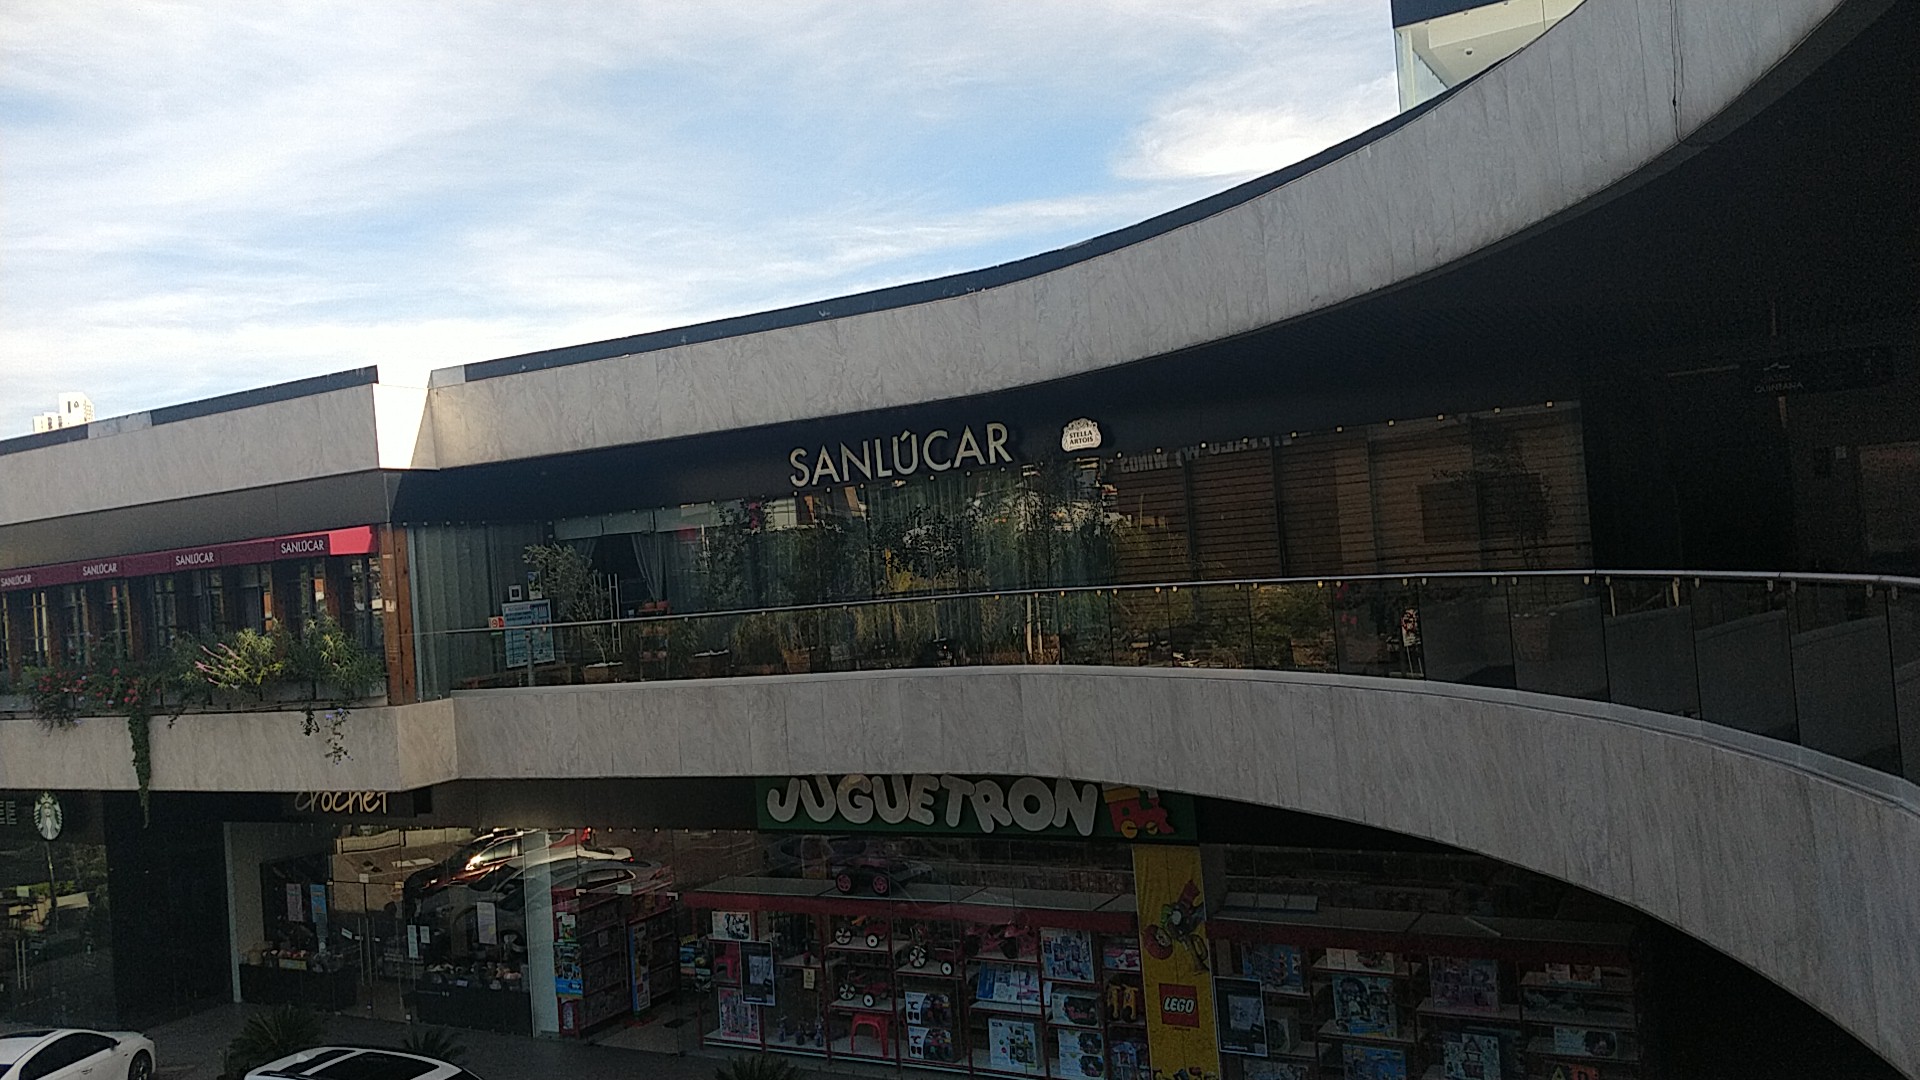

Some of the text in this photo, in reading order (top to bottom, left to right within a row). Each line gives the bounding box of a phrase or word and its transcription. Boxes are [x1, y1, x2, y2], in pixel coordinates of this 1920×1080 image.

[1069, 430, 1092, 439] STELLA
[1069, 436, 1093, 445] ARTOIS
[790, 422, 1013, 488] SANLÚCAR
[767, 774, 1098, 836] JUGUETRON
[1163, 995, 1196, 1014] LEGO
